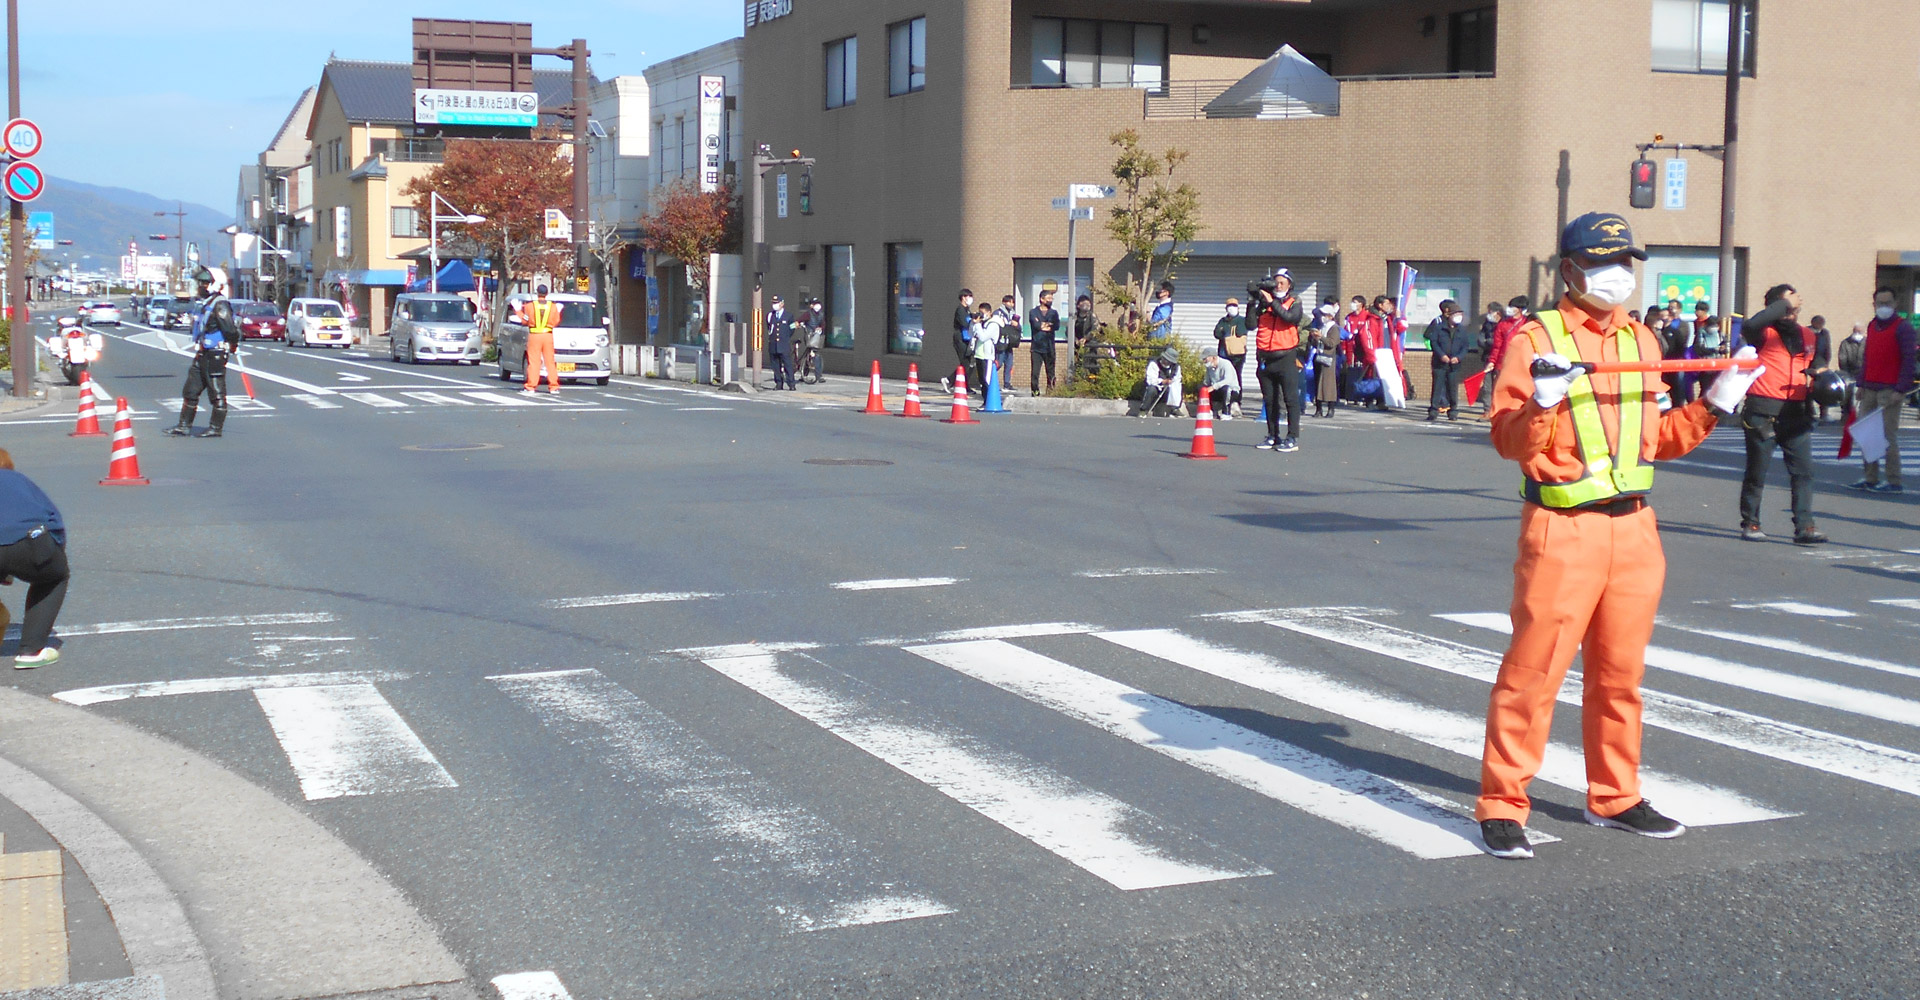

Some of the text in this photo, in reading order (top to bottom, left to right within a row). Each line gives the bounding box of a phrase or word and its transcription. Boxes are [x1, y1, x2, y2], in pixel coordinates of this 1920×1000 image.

[437, 94, 518, 110] 丹後海と星の見える丘公園
[13, 130, 33, 147] 40
[547, 211, 558, 223] P
